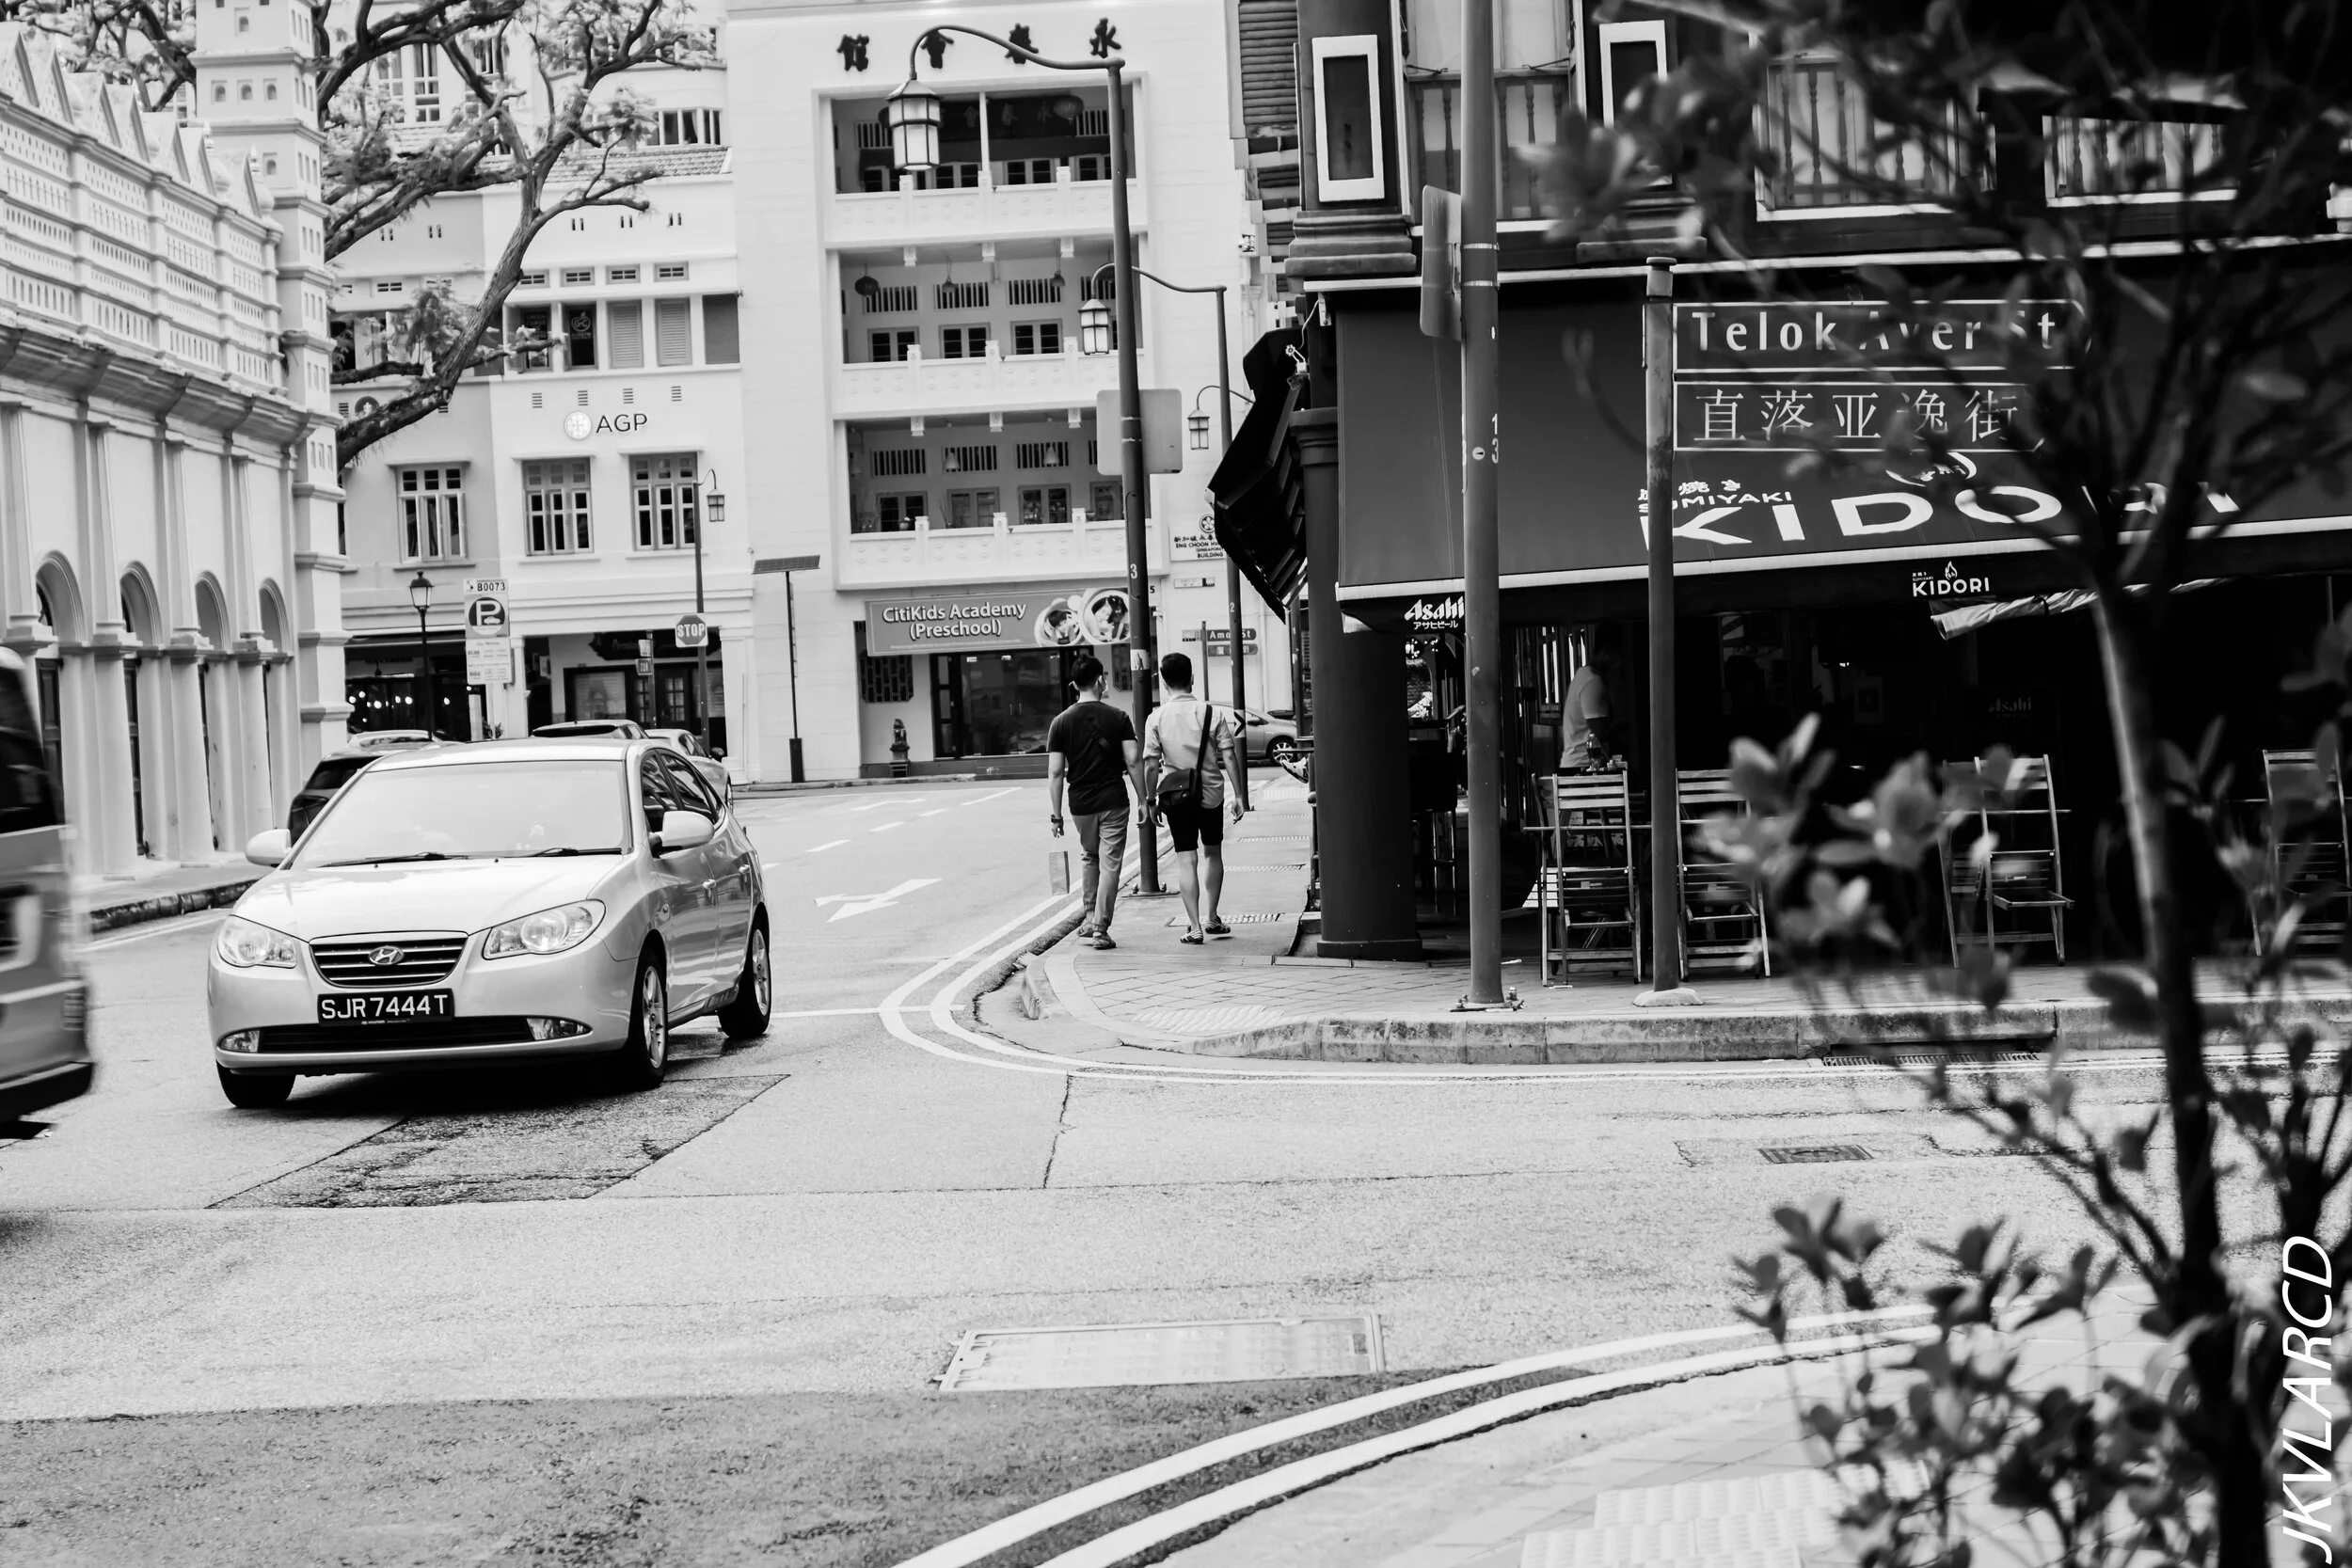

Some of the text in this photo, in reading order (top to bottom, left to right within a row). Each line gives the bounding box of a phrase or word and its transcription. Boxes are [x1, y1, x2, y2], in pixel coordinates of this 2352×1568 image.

[1692, 311, 1837, 351] Telok
[596, 413, 648, 434] AGP
[1638, 491, 1792, 514] SMIYAKI
[1130, 563, 1137, 578] 3
[477, 582, 505, 592] B0073
[1913, 578, 1990, 596] KIDORI
[882, 602, 1026, 623] CitiKids Academy
[1230, 602, 1235, 612] 2
[1405, 595, 1465, 621] Asahi
[676, 623, 705, 638] STOP
[910, 619, 1002, 641] (Preschool)
[1413, 620, 1459, 630] アサヒビール
[1210, 630, 1231, 640] Amo
[321, 994, 448, 1020] SJR7444T
